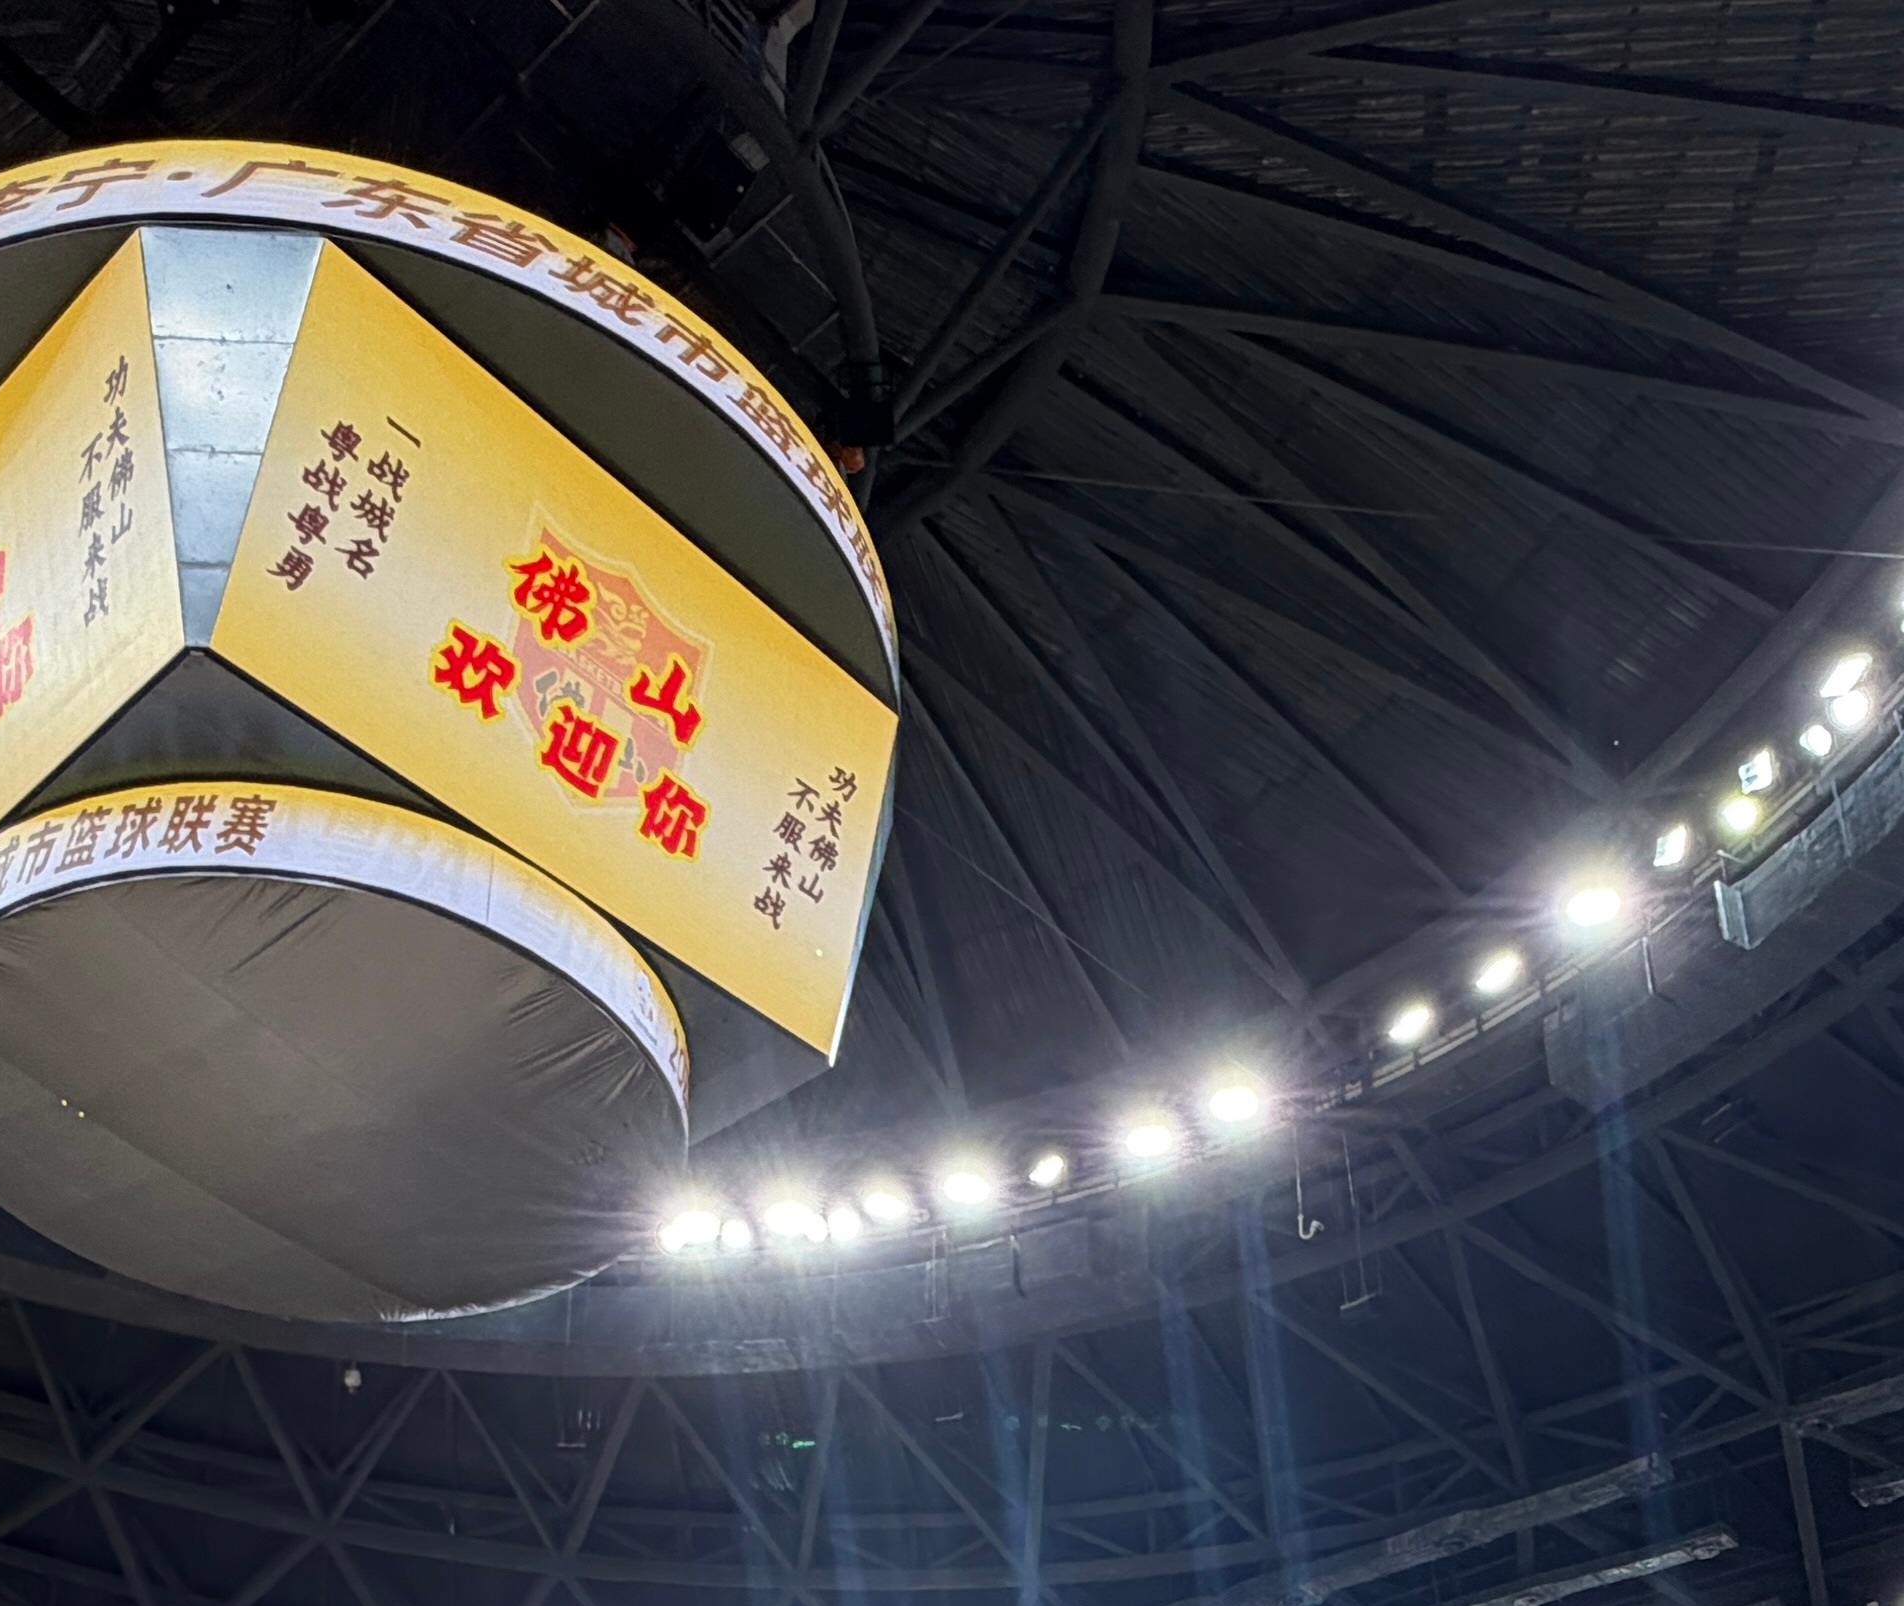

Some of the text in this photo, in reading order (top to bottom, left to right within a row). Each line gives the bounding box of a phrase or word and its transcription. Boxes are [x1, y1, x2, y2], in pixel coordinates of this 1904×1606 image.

[78, 431, 109, 627] 不服来战
[103, 355, 134, 545] 功夫佛山
[266, 420, 362, 591] 粤战粤勇
[335, 416, 421, 580] 一战城名
[509, 552, 703, 745] 佛山
[434, 626, 707, 858] 欢迎你
[754, 777, 819, 929] 不服来战
[799, 765, 858, 904] 功夫佛山
